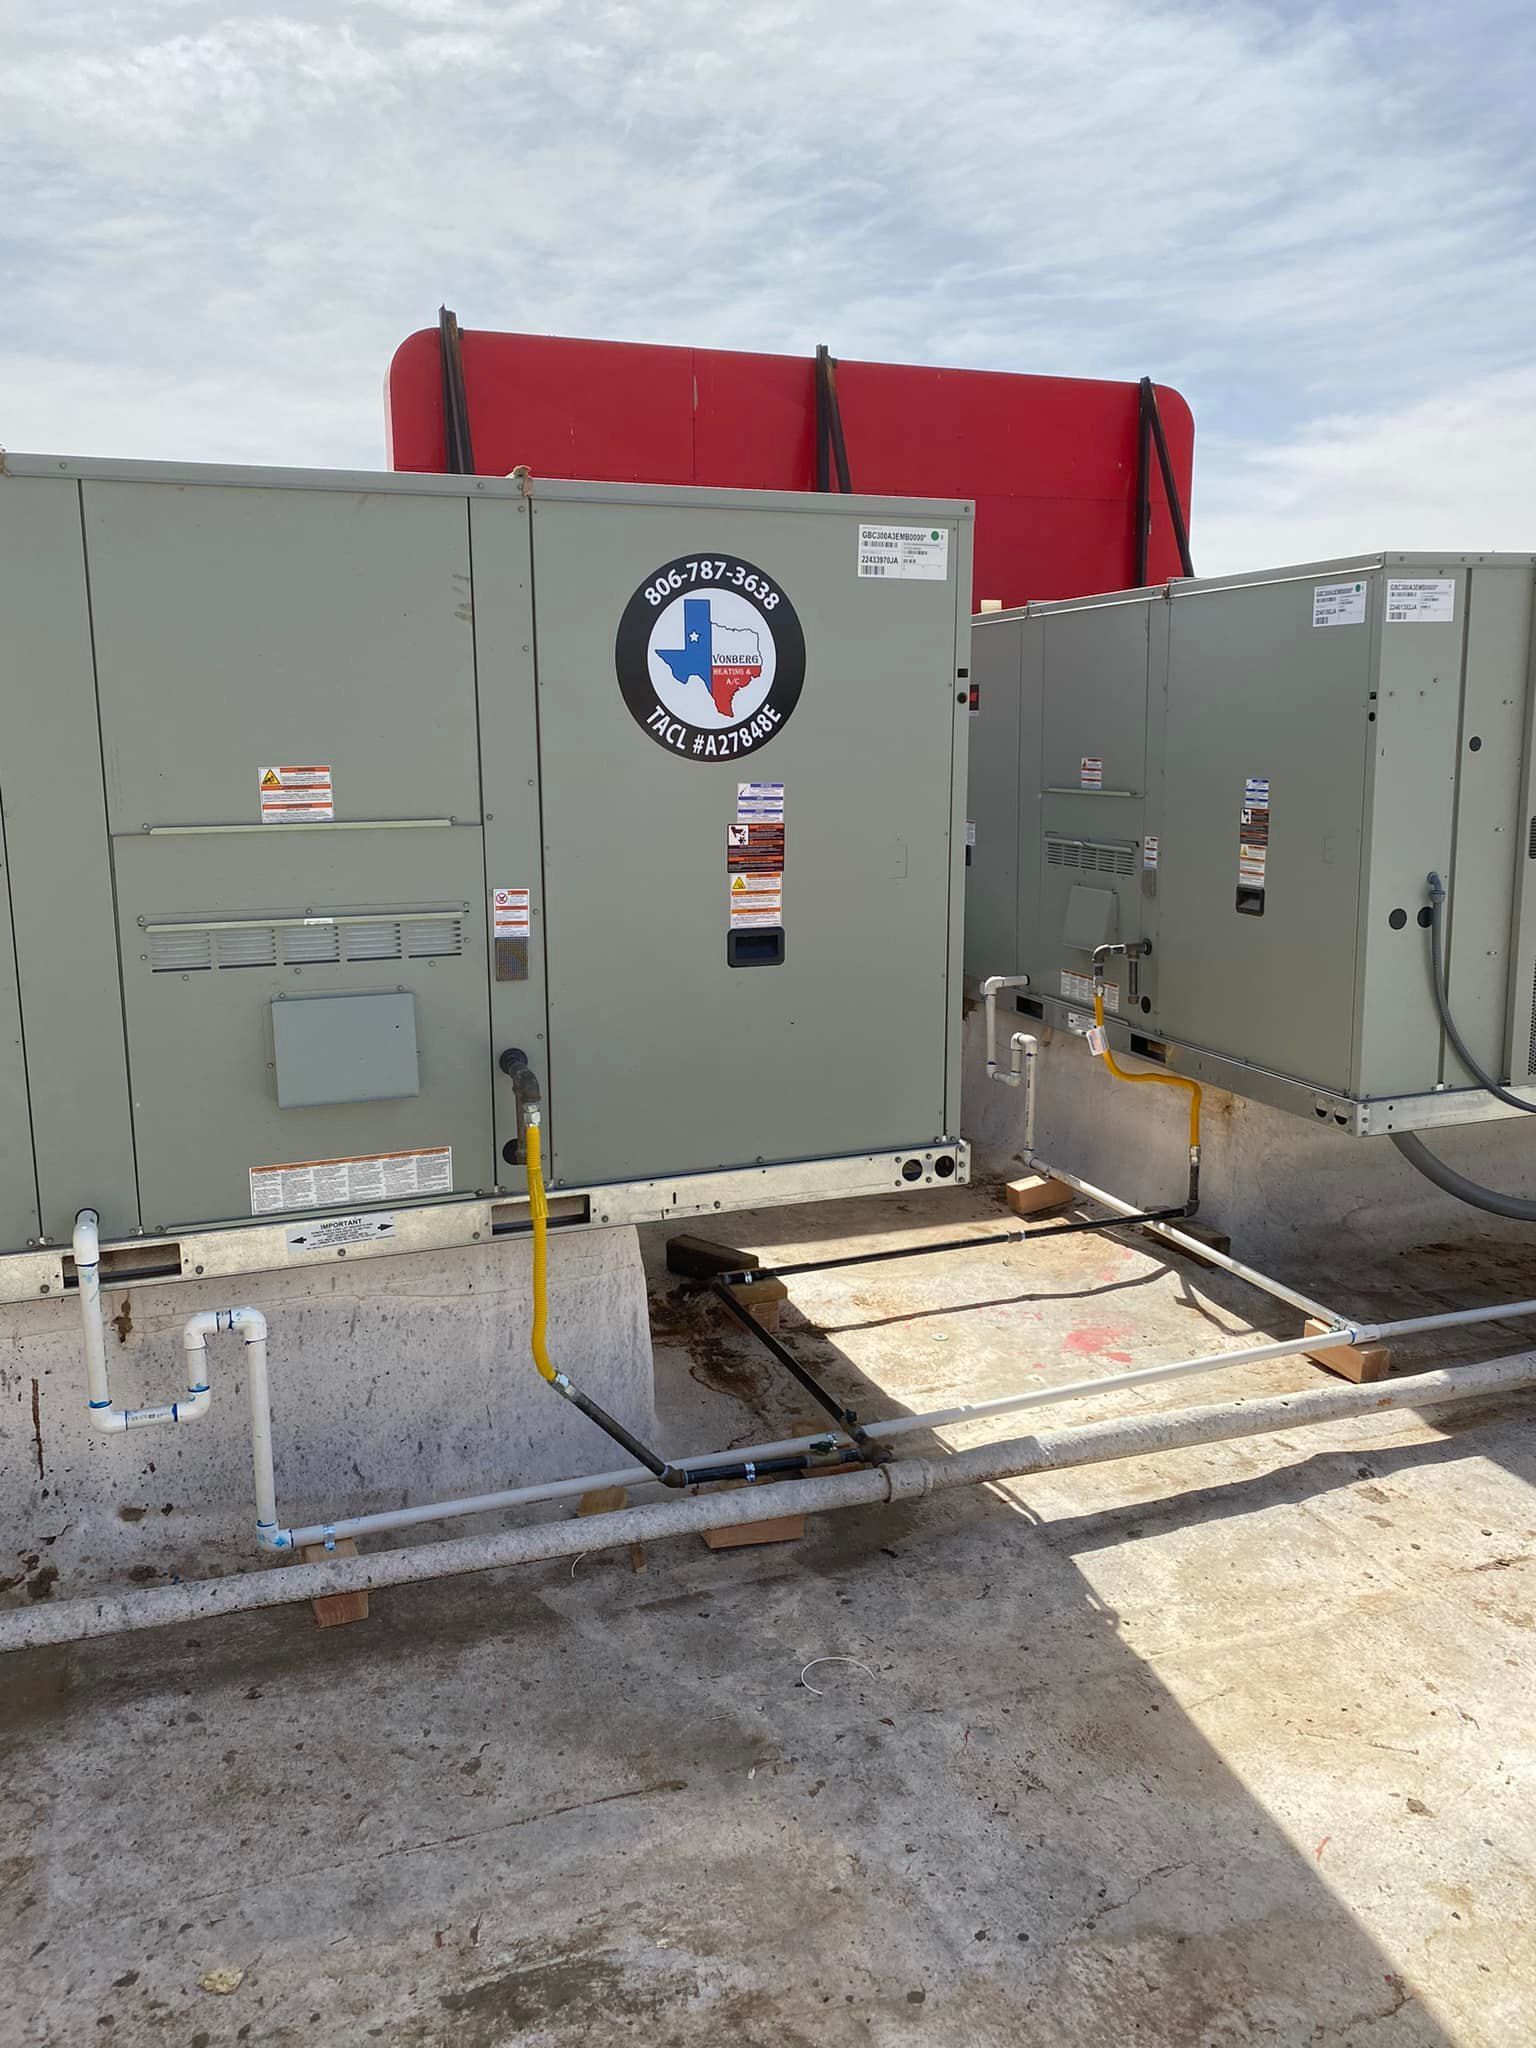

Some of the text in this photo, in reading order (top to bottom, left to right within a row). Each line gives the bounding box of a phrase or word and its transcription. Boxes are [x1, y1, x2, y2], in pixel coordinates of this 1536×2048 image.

[644, 560, 780, 610] 806-787-3638
[712, 654, 759, 664] VONBERG
[646, 703, 782, 756] TACL #A27848E
[320, 1218, 362, 1230] IMPORTANT
